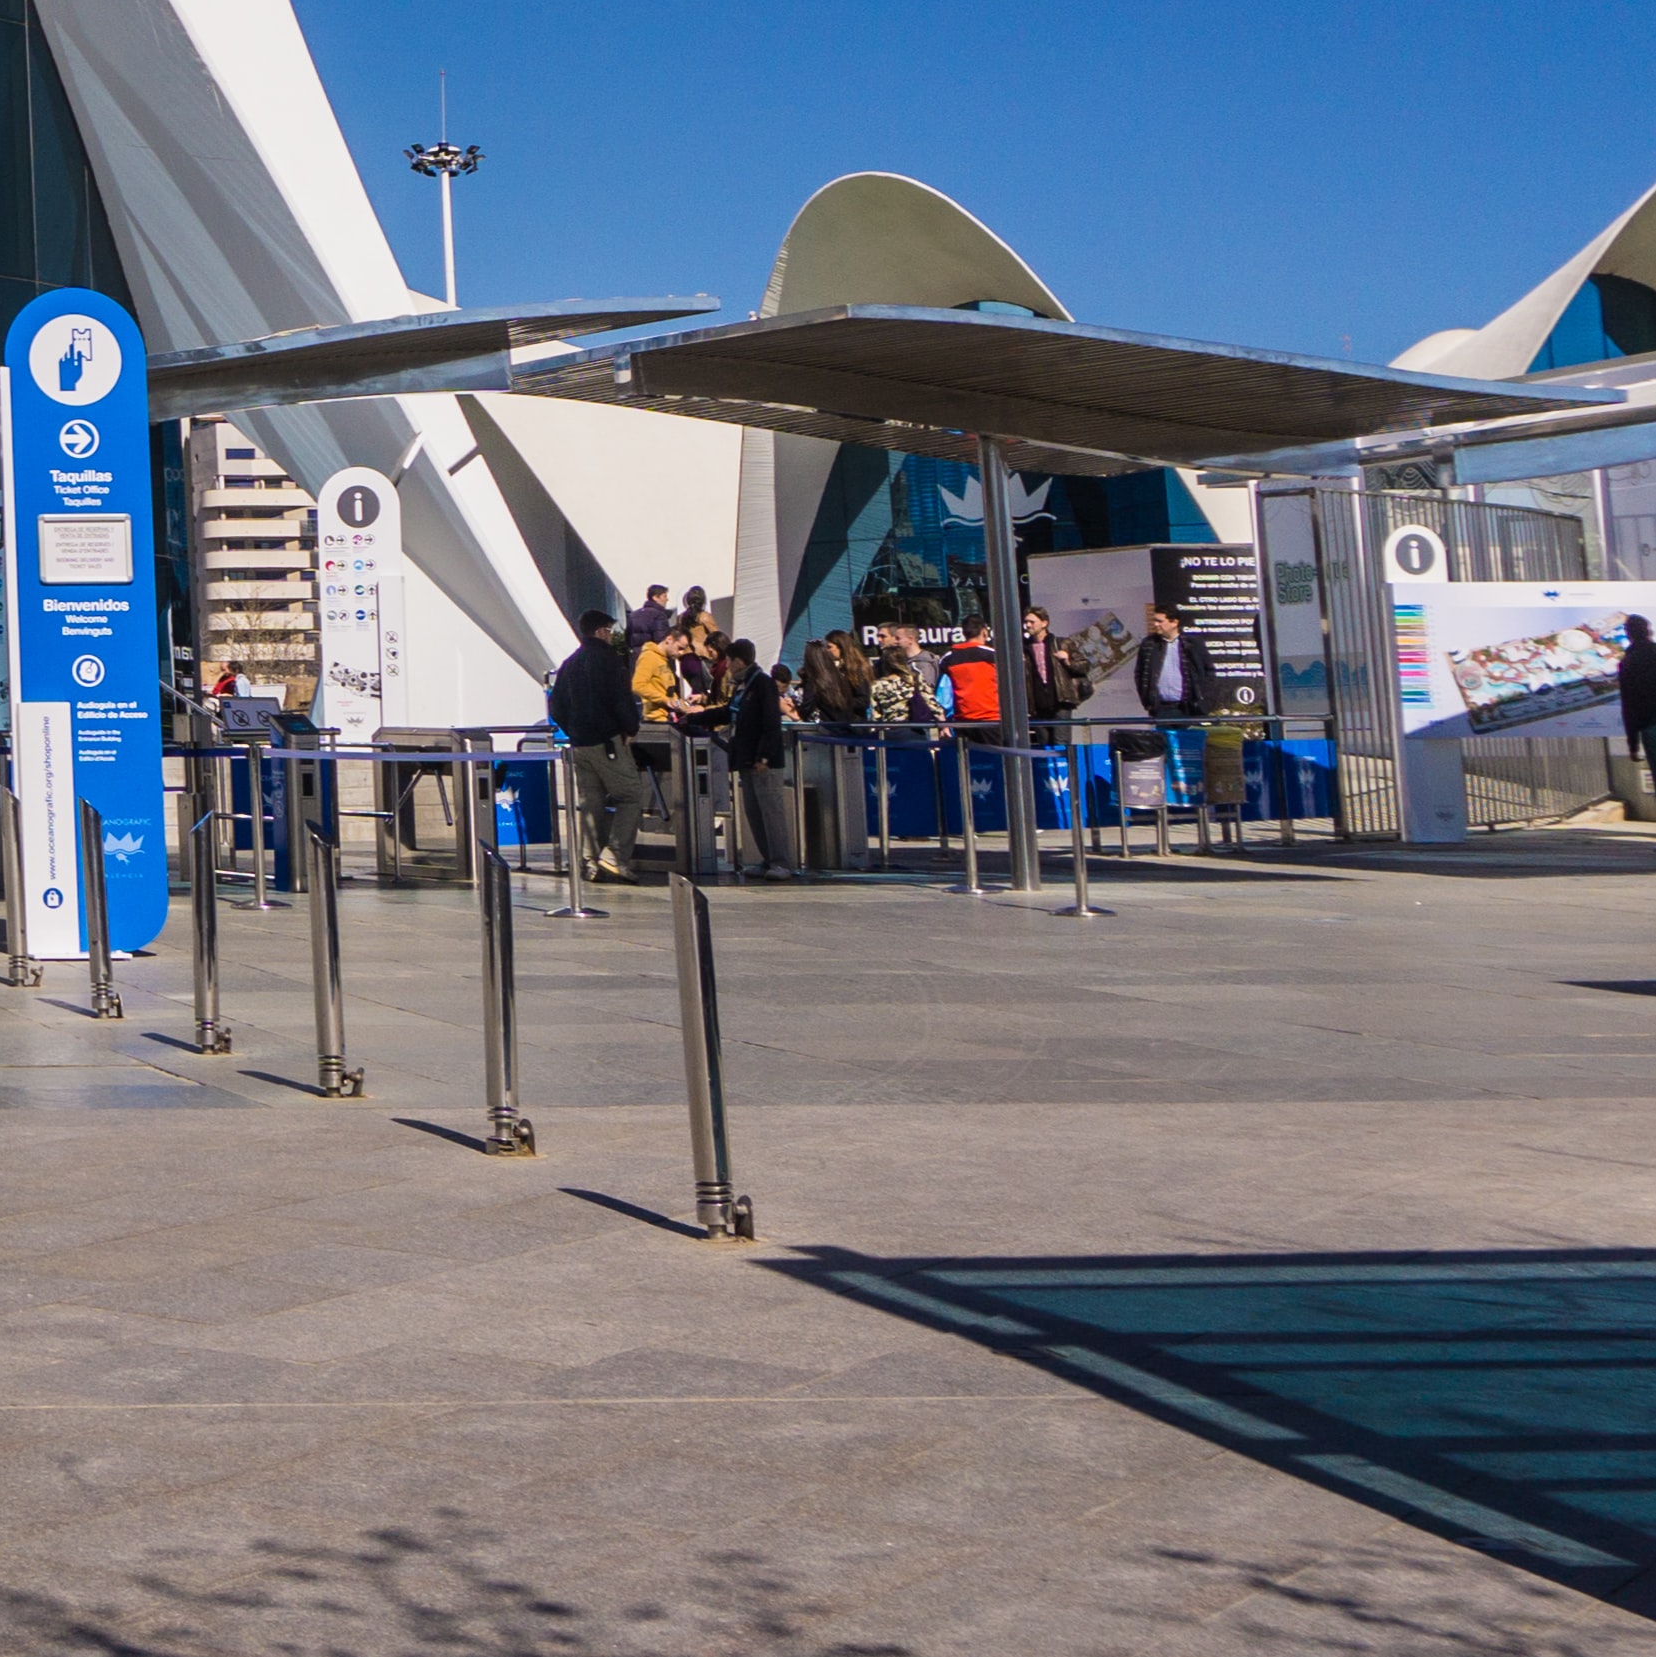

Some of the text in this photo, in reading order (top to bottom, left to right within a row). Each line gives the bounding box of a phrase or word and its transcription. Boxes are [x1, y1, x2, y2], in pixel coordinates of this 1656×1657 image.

[49, 469, 113, 485] Taquillas
[53, 485, 110, 494] Ticket Office
[62, 496, 102, 507] Taquilles
[1202, 556, 1218, 566] TE
[1219, 556, 1235, 566] LO
[43, 599, 130, 612] Bienvenidos
[65, 614, 108, 624] Welcome
[62, 626, 113, 637] Benvinguts
[44, 715, 56, 881] www.oceanografic.org/shoponline
